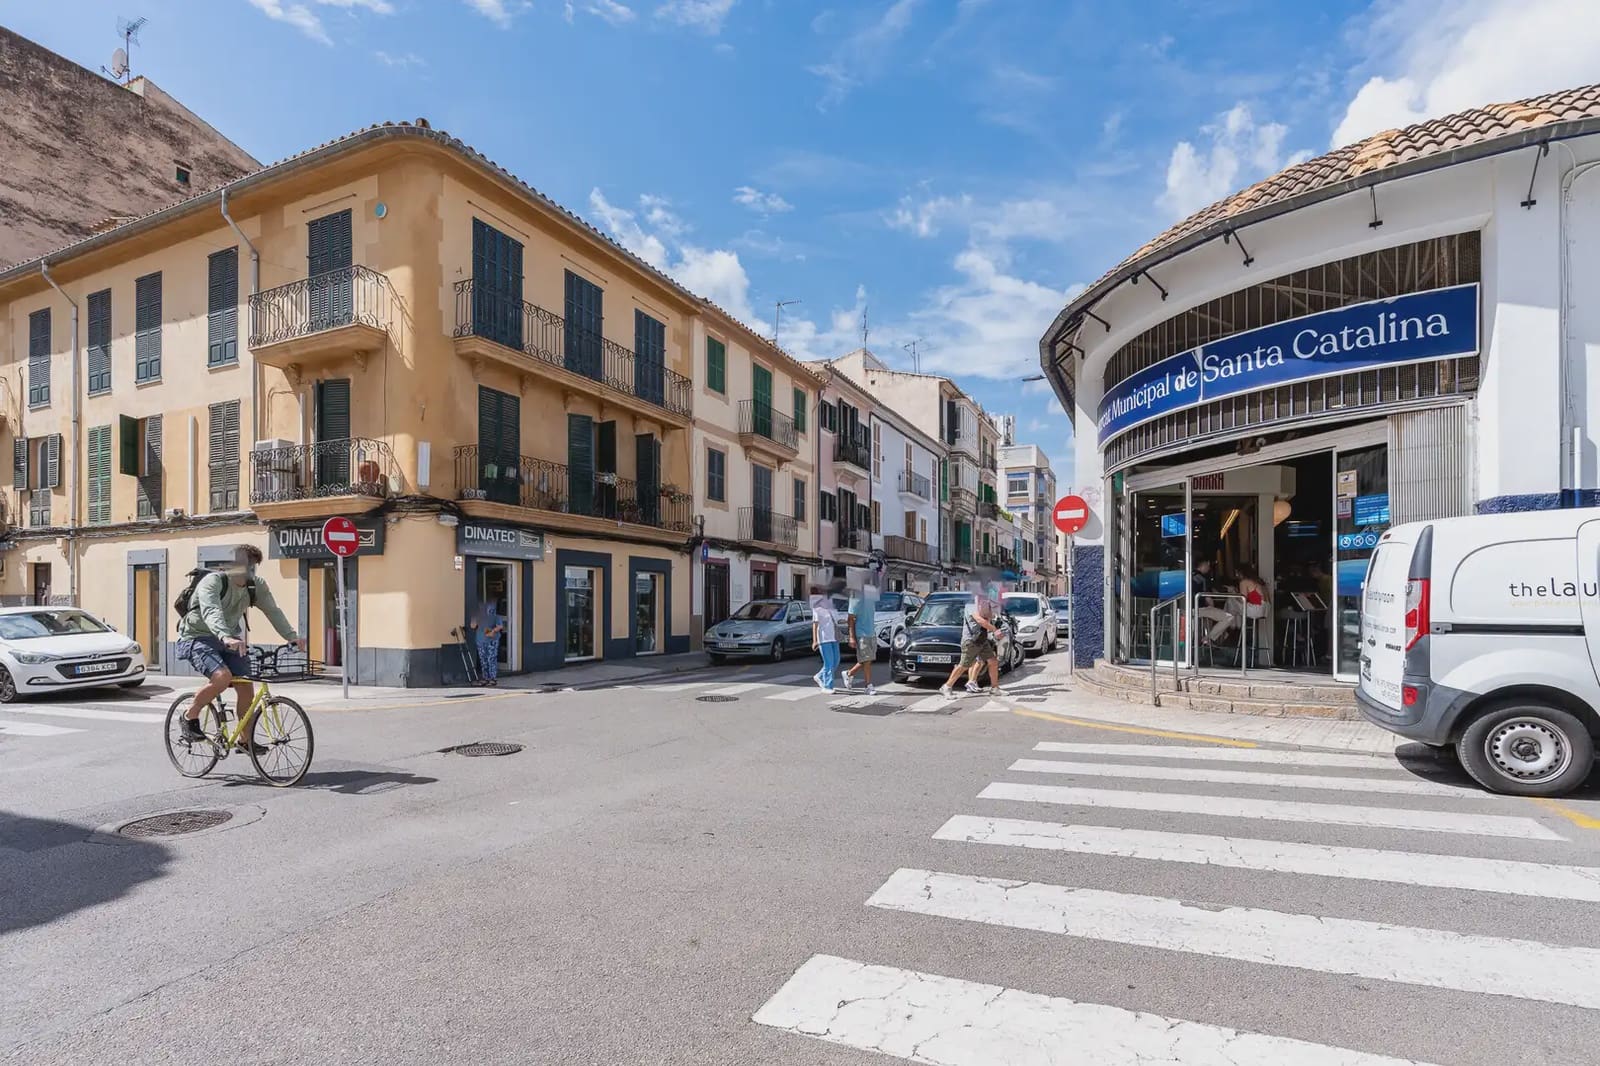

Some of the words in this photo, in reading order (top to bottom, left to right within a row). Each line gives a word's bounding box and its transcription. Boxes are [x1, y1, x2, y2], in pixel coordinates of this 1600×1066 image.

[1111, 372, 1170, 421] Municipal
[1174, 365, 1198, 392] de
[1203, 344, 1284, 382] Santa
[1293, 312, 1450, 360] Catalina
[280, 527, 326, 547] DINAT
[464, 526, 516, 543] DINATEC
